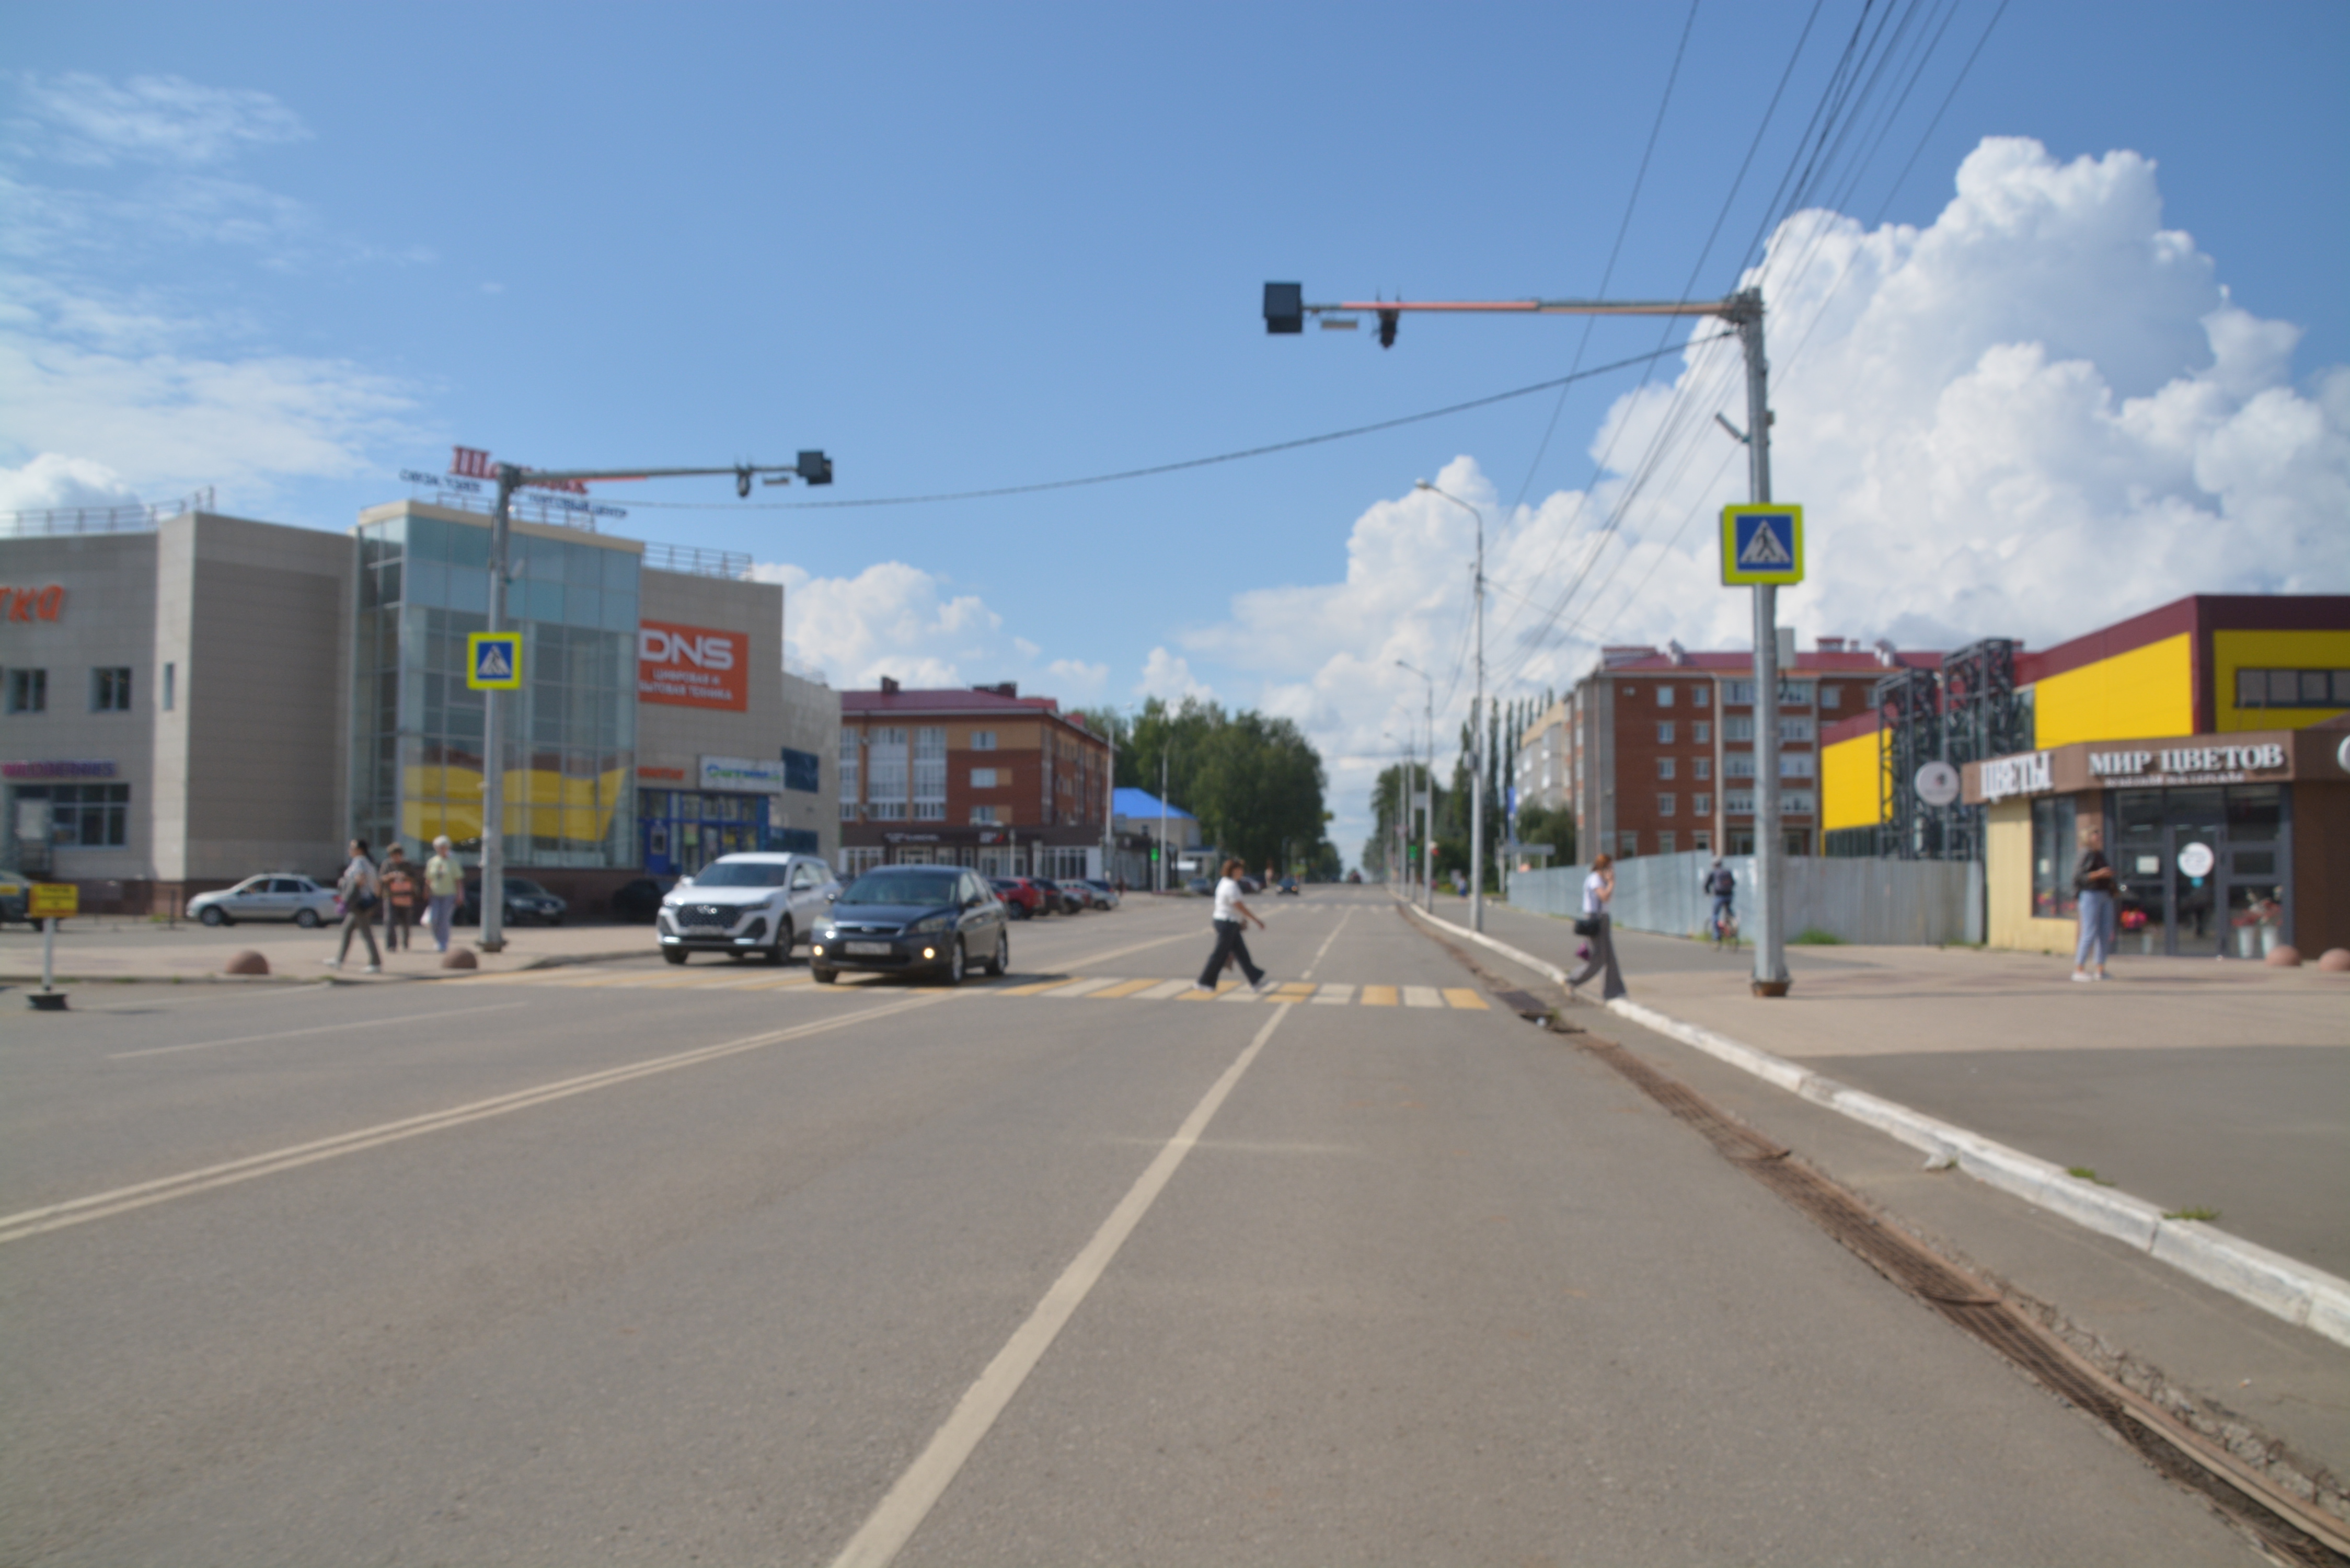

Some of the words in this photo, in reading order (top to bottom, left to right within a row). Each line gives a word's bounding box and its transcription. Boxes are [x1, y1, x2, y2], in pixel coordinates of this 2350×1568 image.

[639, 629, 733, 670] DNS
[639, 681, 686, 696] БЫТОВАЯ
[688, 686, 732, 700] ТЕХНИКА
[654, 669, 709, 684] ЦИФРОВАЯ
[2089, 751, 2152, 775] МИР
[2160, 744, 2284, 774] ЦВЕТОВ
[1980, 751, 2053, 804] ЦВЕТЫ
